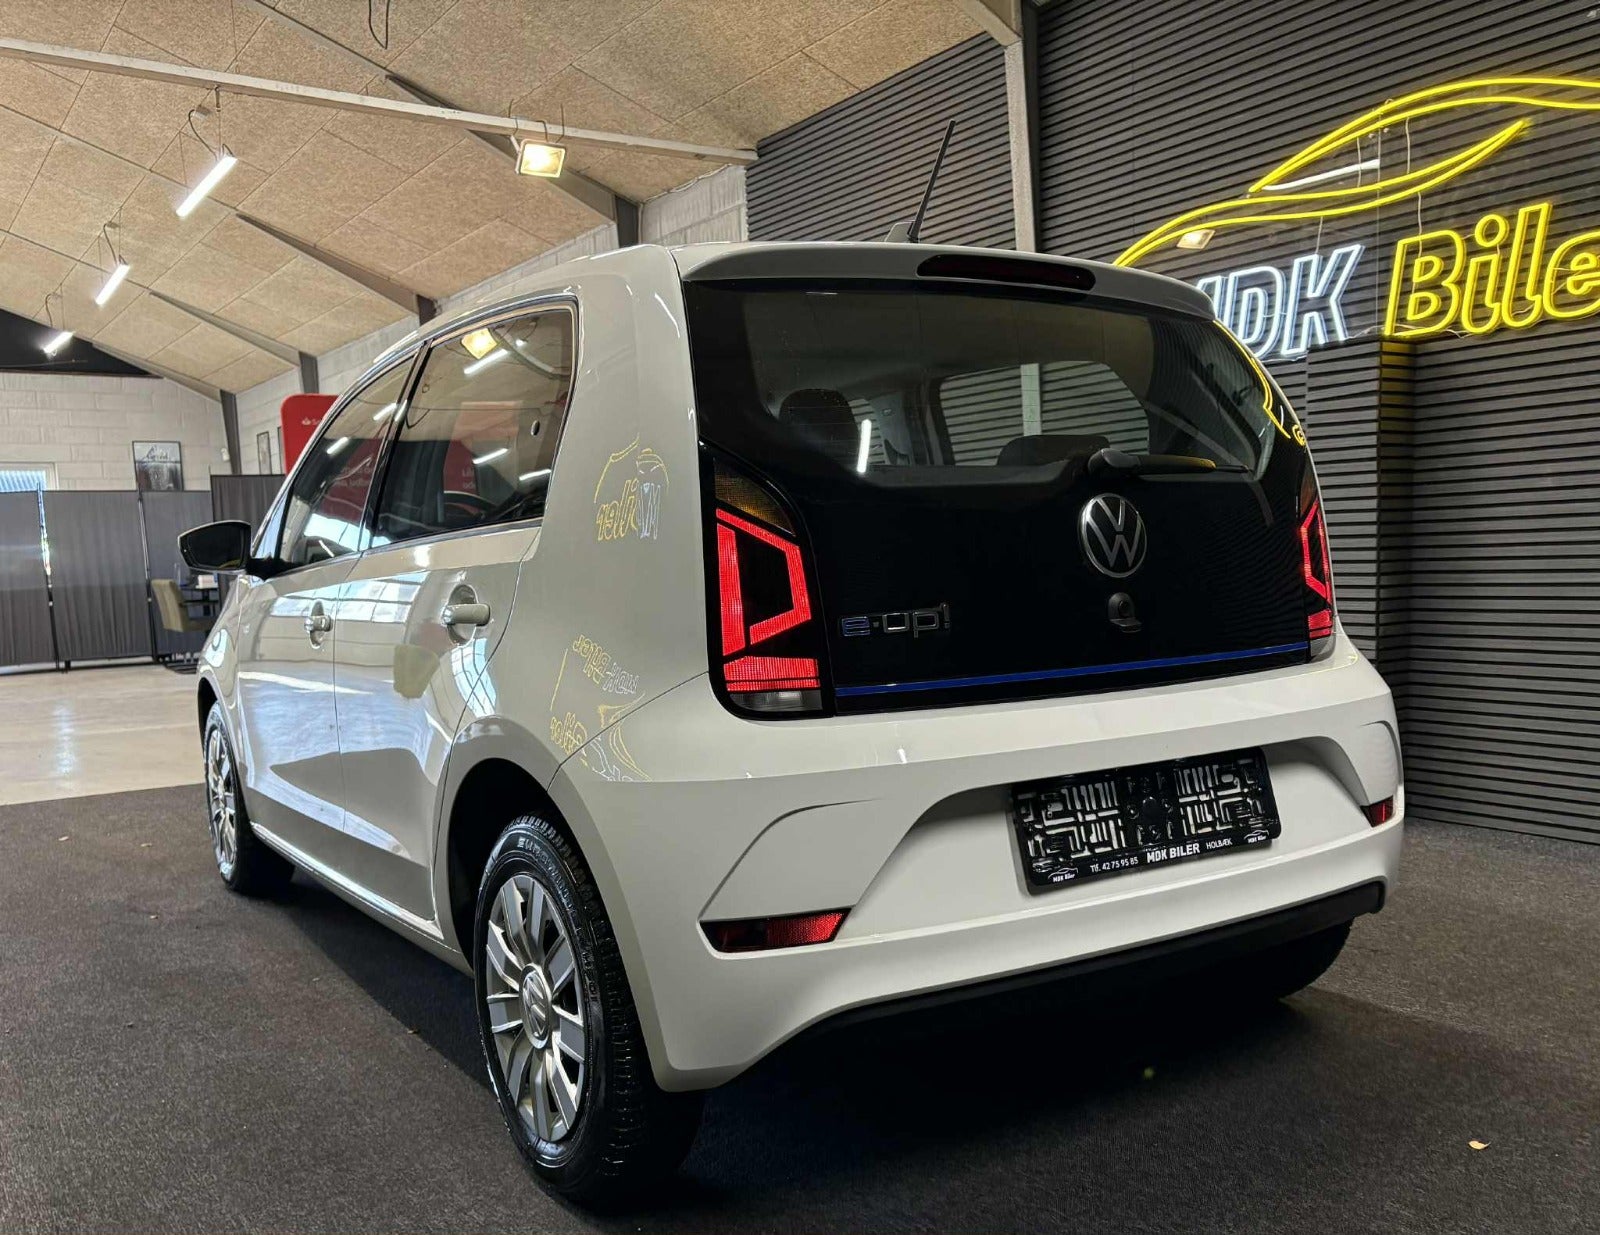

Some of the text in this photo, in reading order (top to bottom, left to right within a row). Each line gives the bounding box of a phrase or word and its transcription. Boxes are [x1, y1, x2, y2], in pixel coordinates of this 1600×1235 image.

[1206, 837, 1233, 850] HOLBÆK
[1146, 842, 1201, 863] MDK BILER
